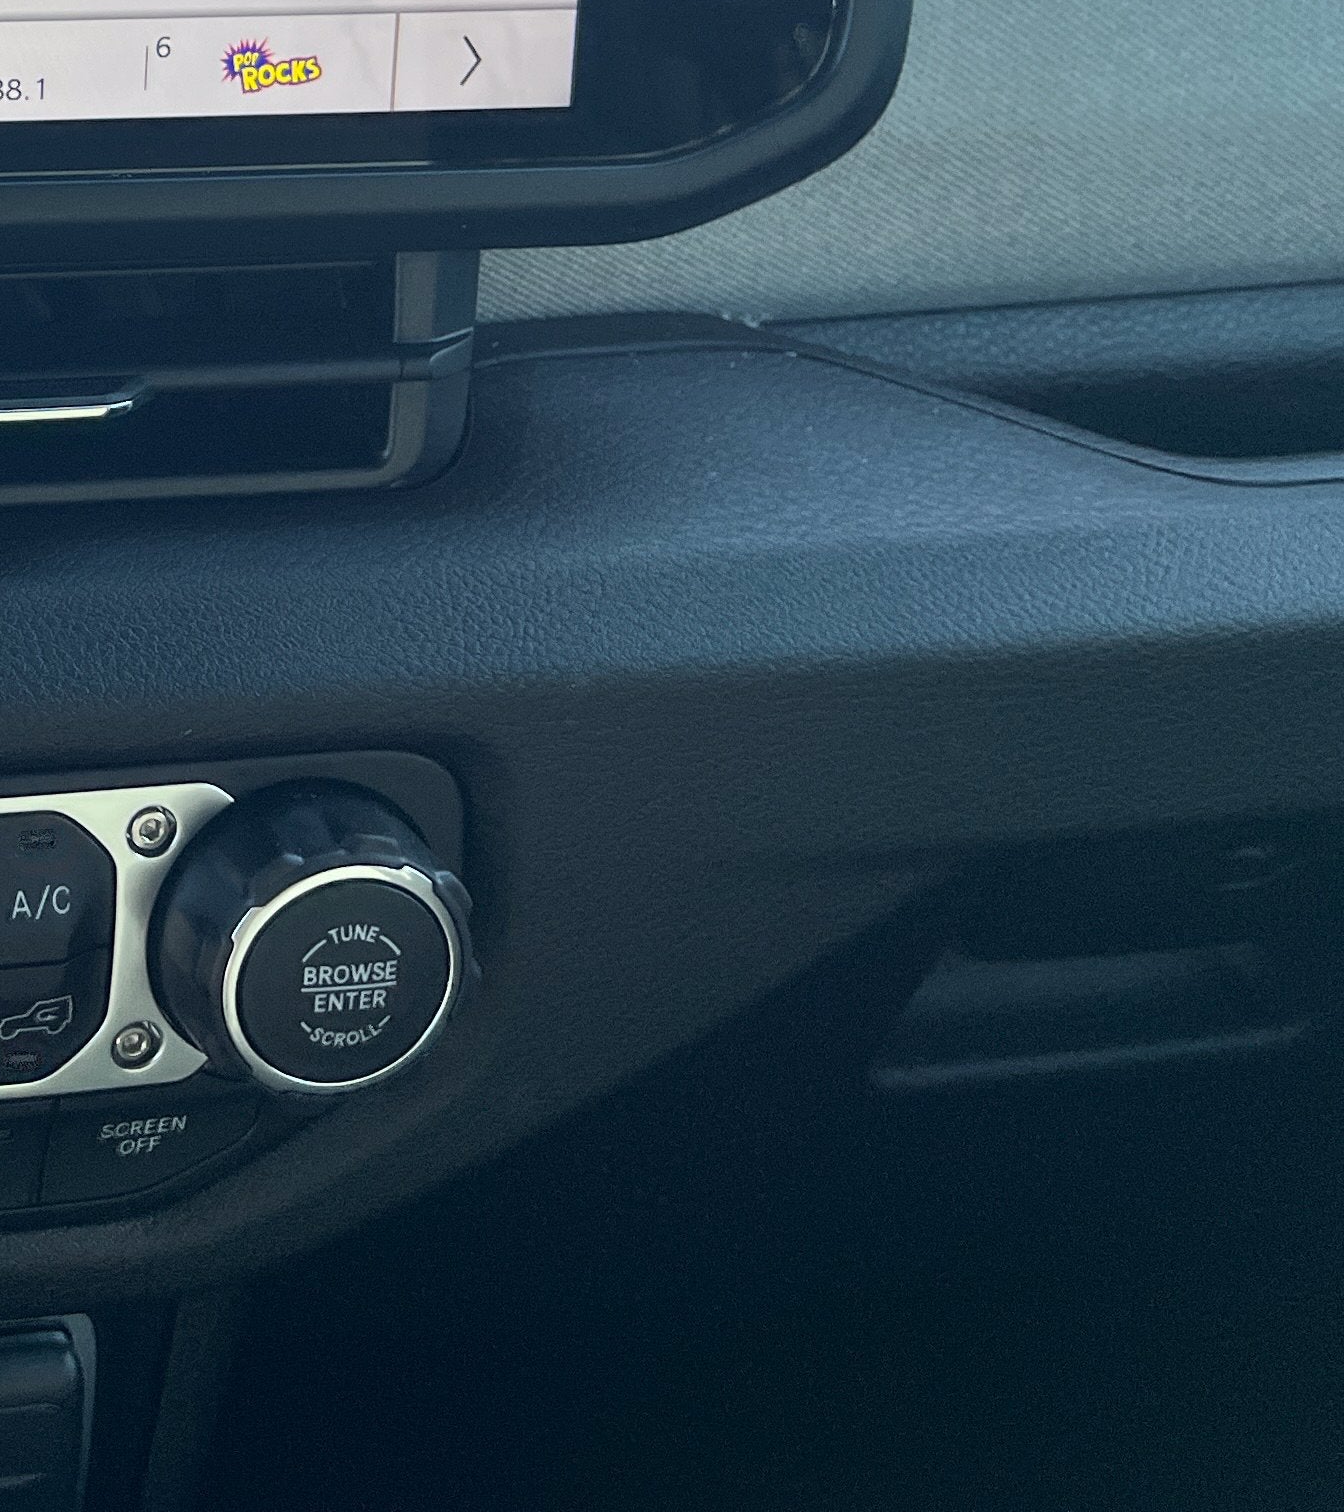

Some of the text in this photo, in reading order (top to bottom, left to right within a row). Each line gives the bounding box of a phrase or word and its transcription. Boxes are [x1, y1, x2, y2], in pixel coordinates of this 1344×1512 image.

[156, 35, 172, 59] 6
[233, 52, 259, 70] POP
[241, 56, 321, 93] ROCKS
[11, 885, 72, 919] A/C
[329, 926, 380, 945] TUNE
[303, 960, 398, 987] BROWSE
[313, 990, 387, 1013] ENTER
[309, 1023, 382, 1048] SCROLL
[100, 1115, 188, 1140] SCREEN
[119, 1135, 162, 1156] OFF
